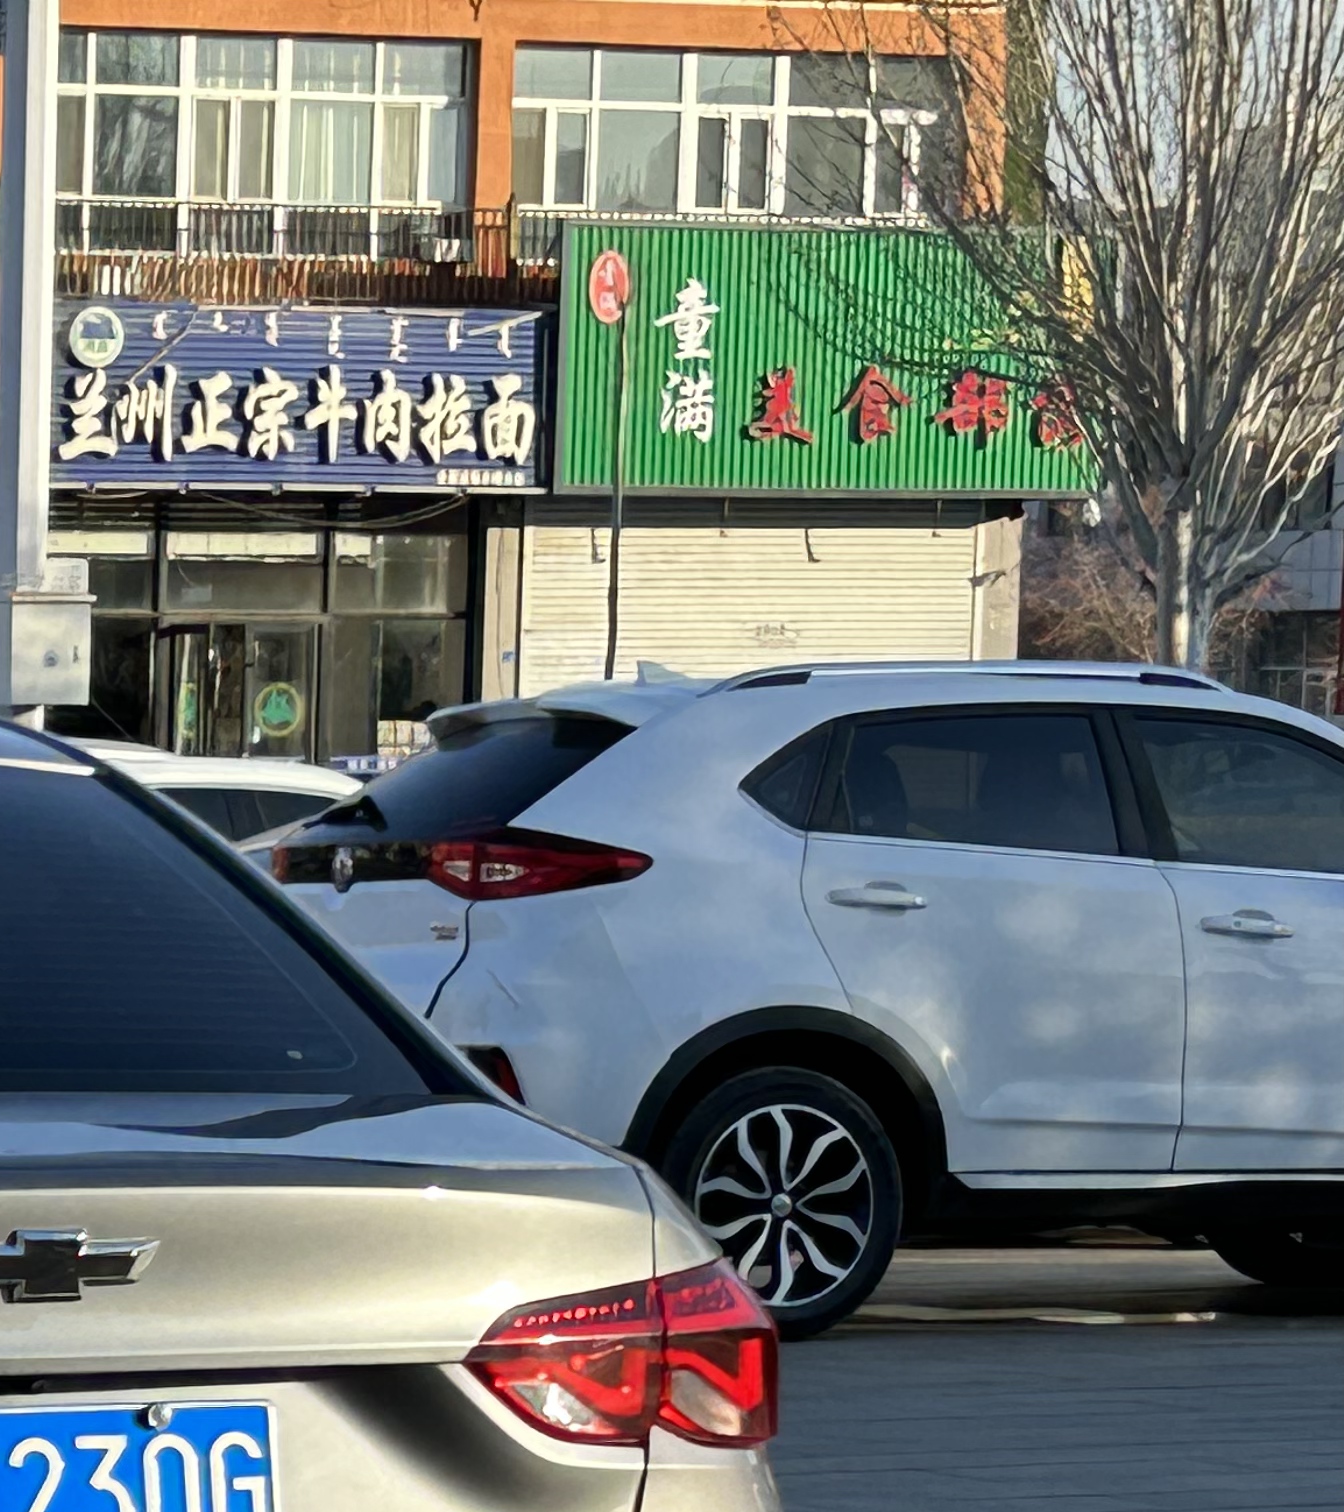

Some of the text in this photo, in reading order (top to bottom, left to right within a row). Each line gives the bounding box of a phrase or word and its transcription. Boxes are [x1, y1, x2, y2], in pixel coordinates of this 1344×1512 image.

[58, 363, 536, 465] 兰州正宗牛肉拉面
